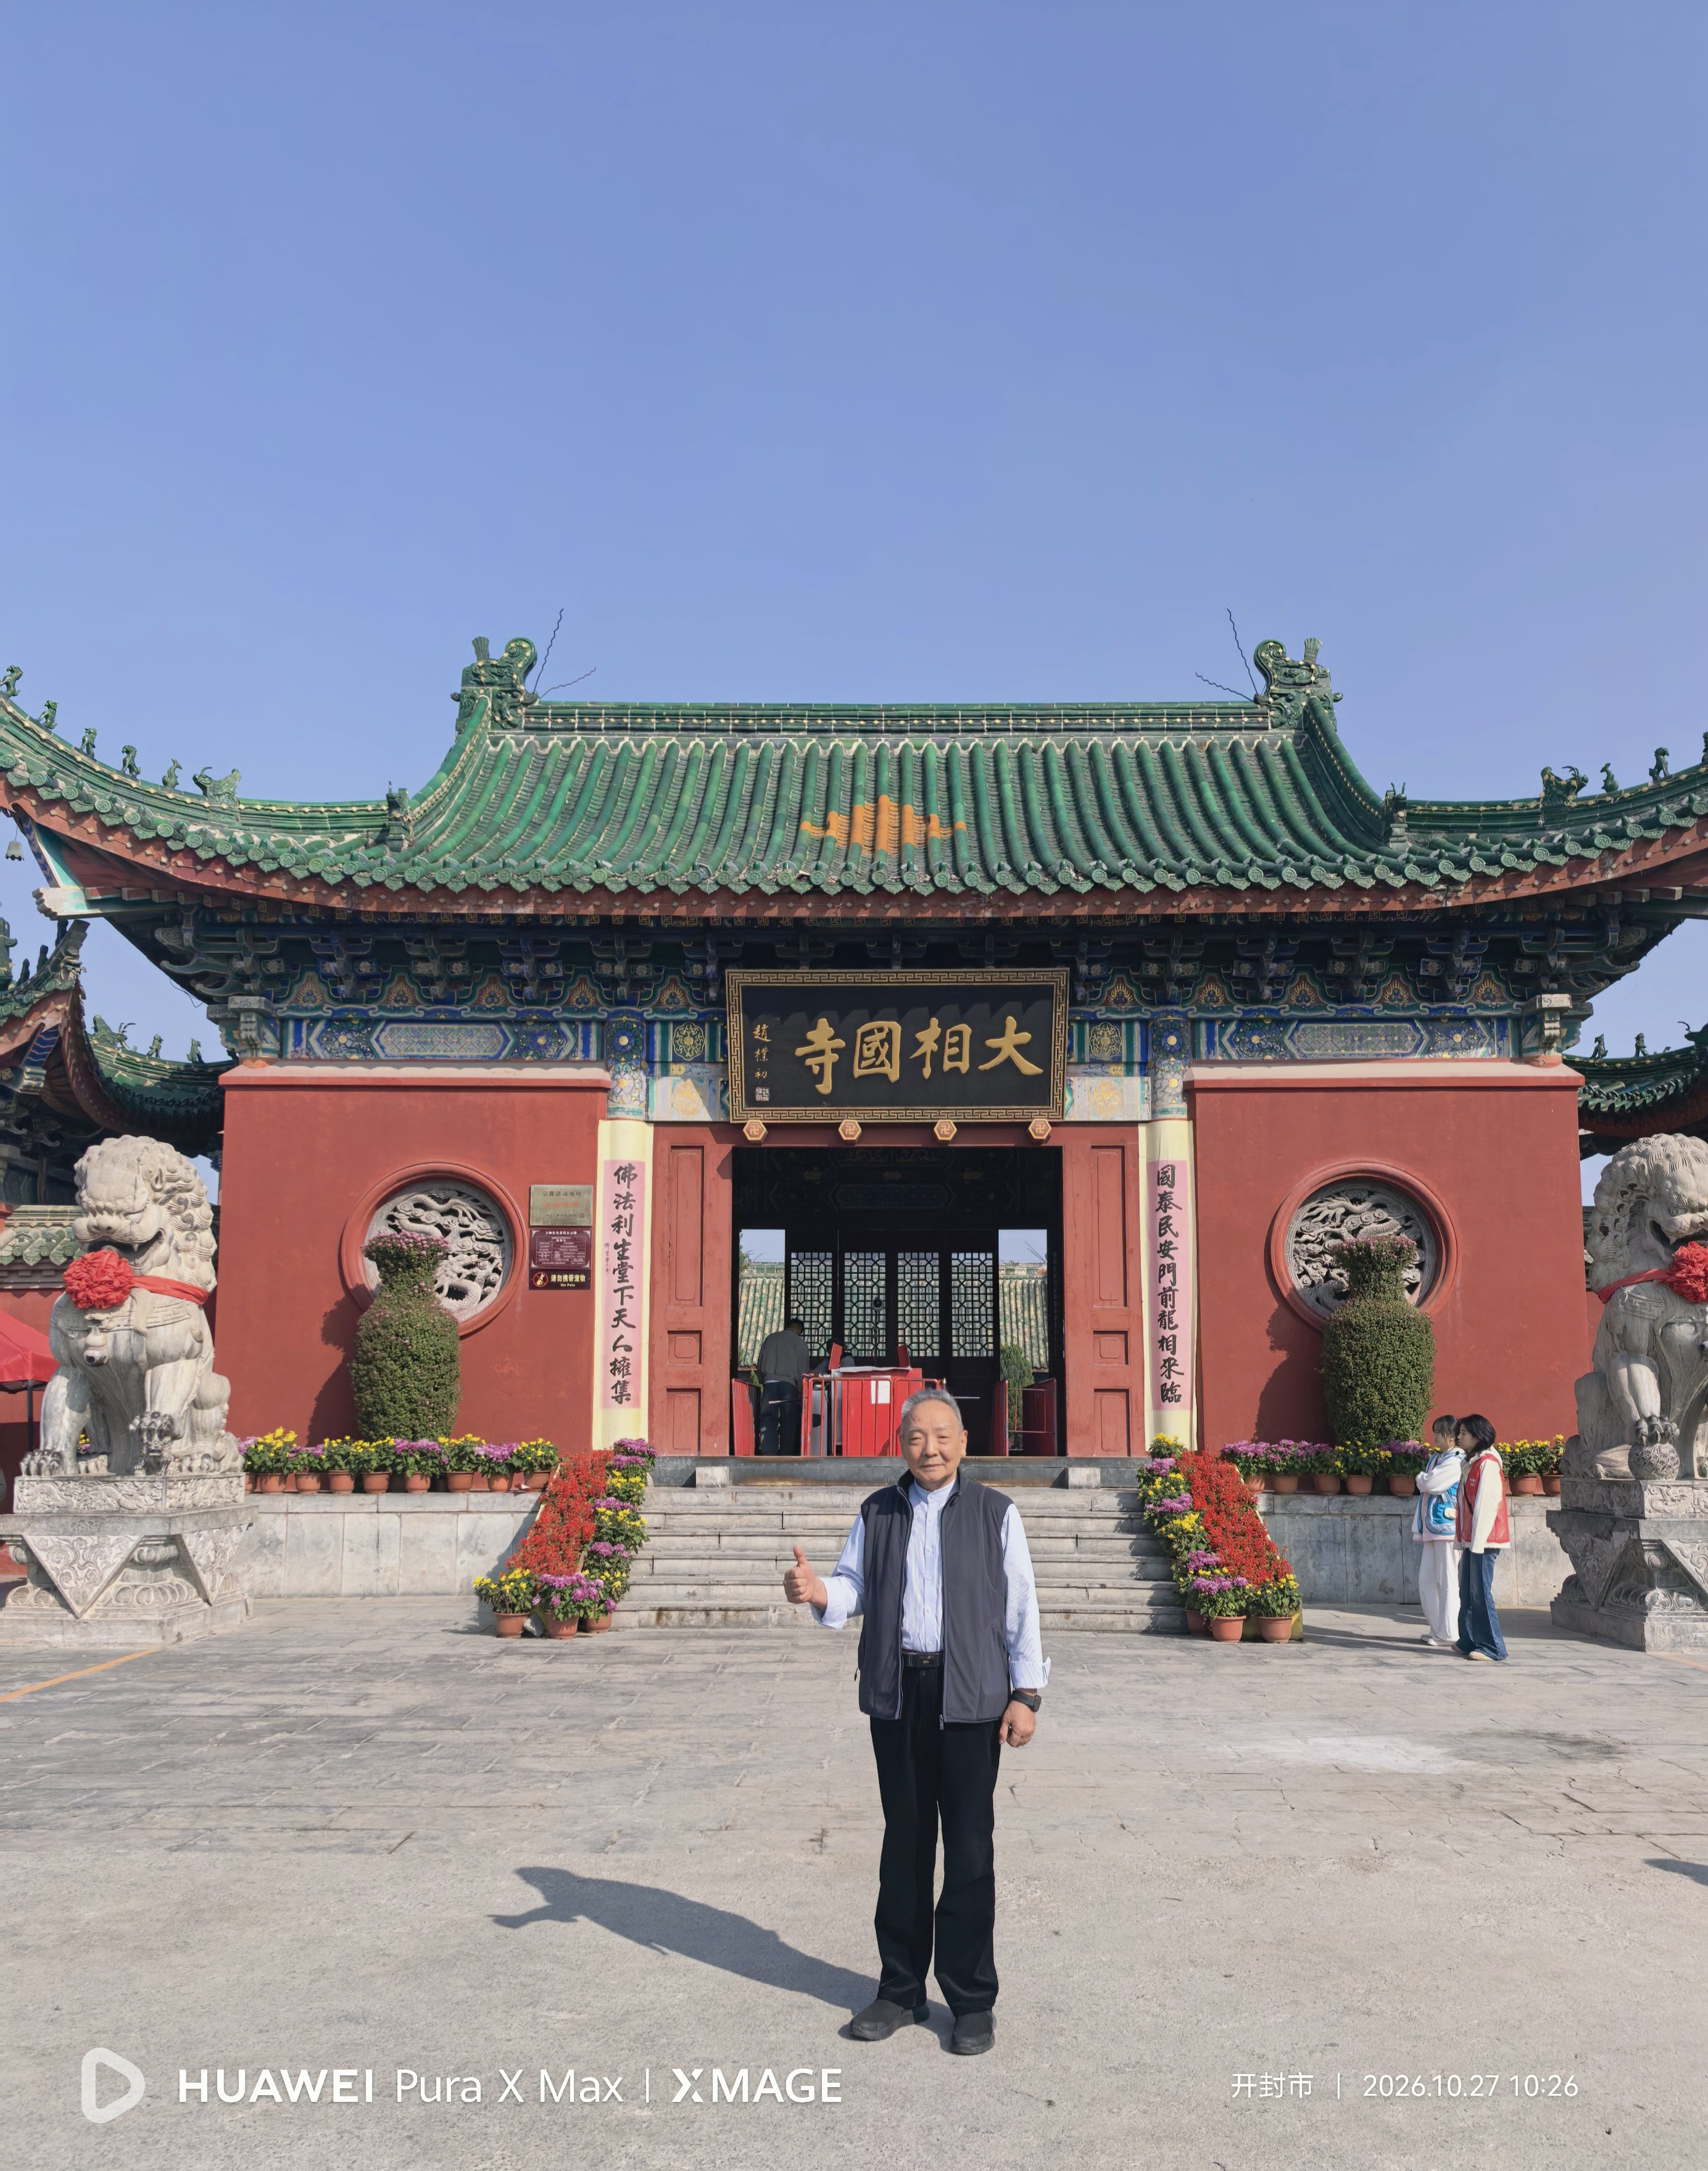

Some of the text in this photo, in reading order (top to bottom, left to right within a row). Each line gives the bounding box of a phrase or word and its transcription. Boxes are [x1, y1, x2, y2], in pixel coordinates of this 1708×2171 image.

[795, 1016, 1043, 1095] 大相國寺
[550, 1274, 586, 1282] 请勿携带宠物
